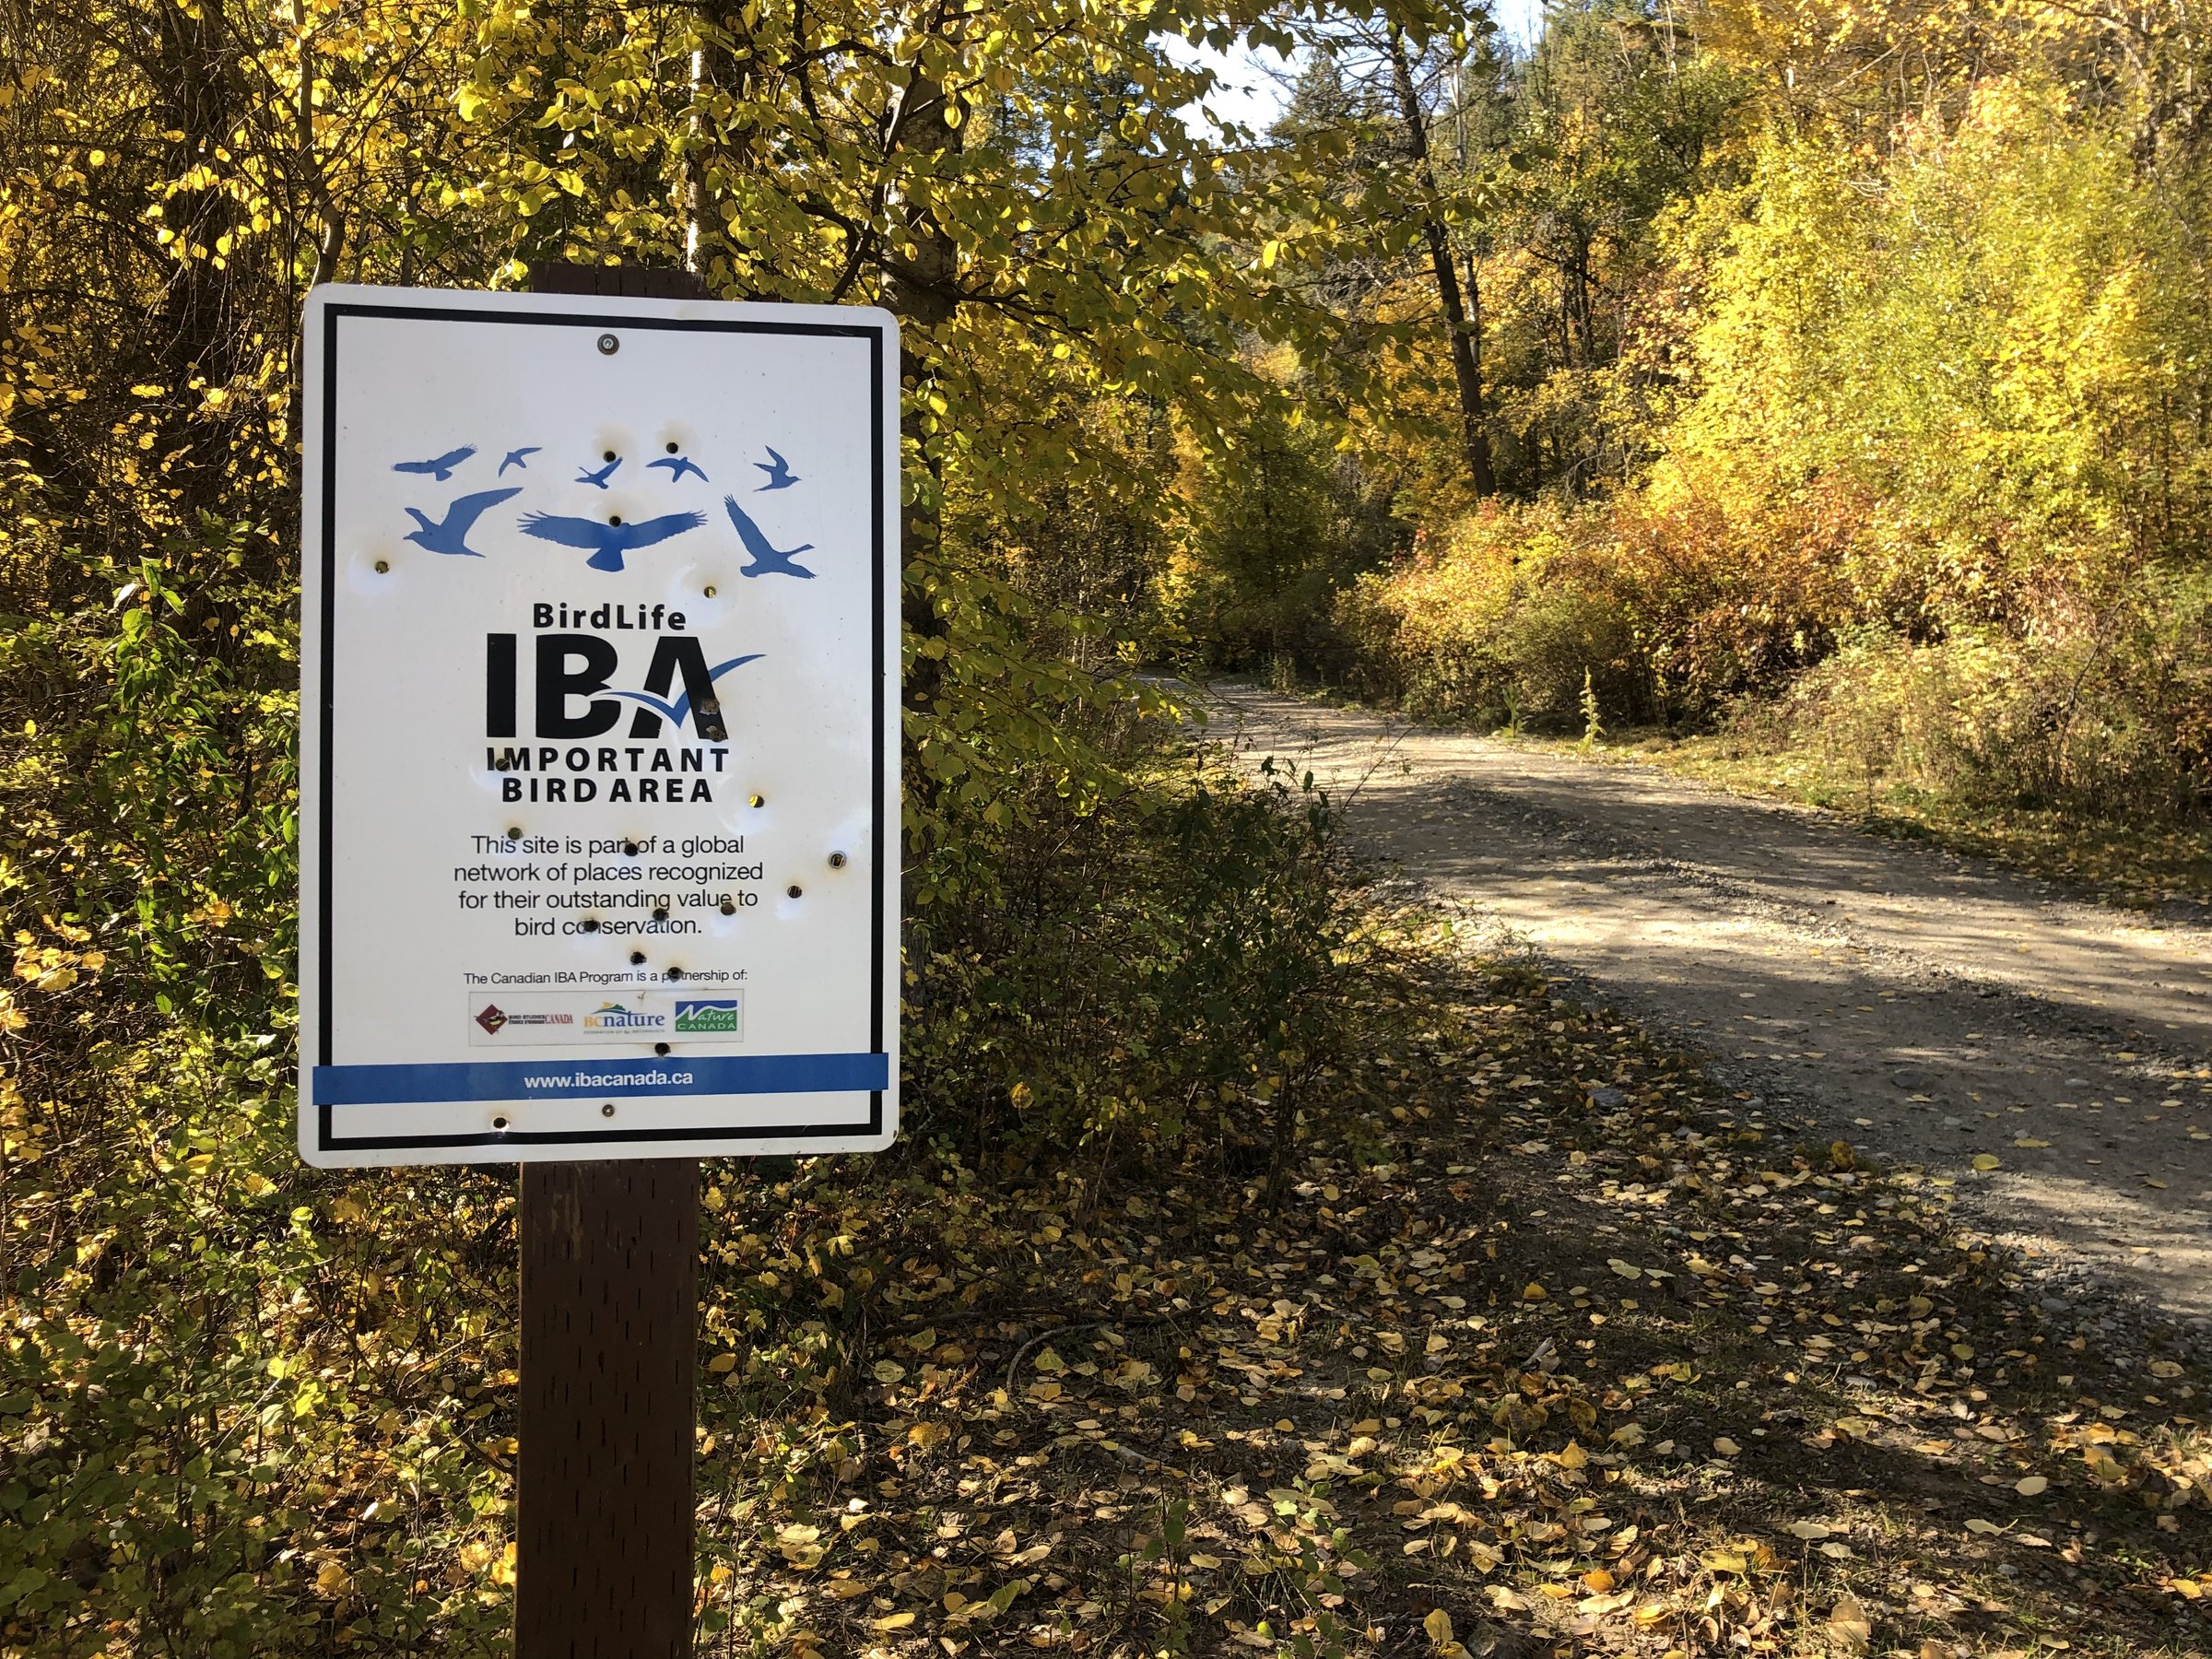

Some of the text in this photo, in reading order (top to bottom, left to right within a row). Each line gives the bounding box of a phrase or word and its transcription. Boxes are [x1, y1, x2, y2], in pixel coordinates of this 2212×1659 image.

[534, 603, 686, 630] BirdLife
[487, 633, 729, 740] IBA
[487, 747, 729, 772] IMPORTANT
[502, 778, 713, 803] BIRD AREA
[471, 835, 516, 854] This
[523, 836, 559, 854] site
[566, 836, 582, 854] is
[638, 835, 658, 854] of
[663, 840, 676, 853] a
[681, 835, 744, 857] global
[454, 862, 764, 885] network of places recognized
[458, 889, 759, 912] for their outstanding value to
[515, 917, 555, 936] bird
[464, 969, 747, 985] The Canadian IBA Program is a ptnership of:
[546, 1014, 573, 1024] CANADA
[678, 1005, 735, 1020] Nature
[677, 1022, 735, 1030] CANADA
[524, 1070, 693, 1088] www.ibacanada.ca
